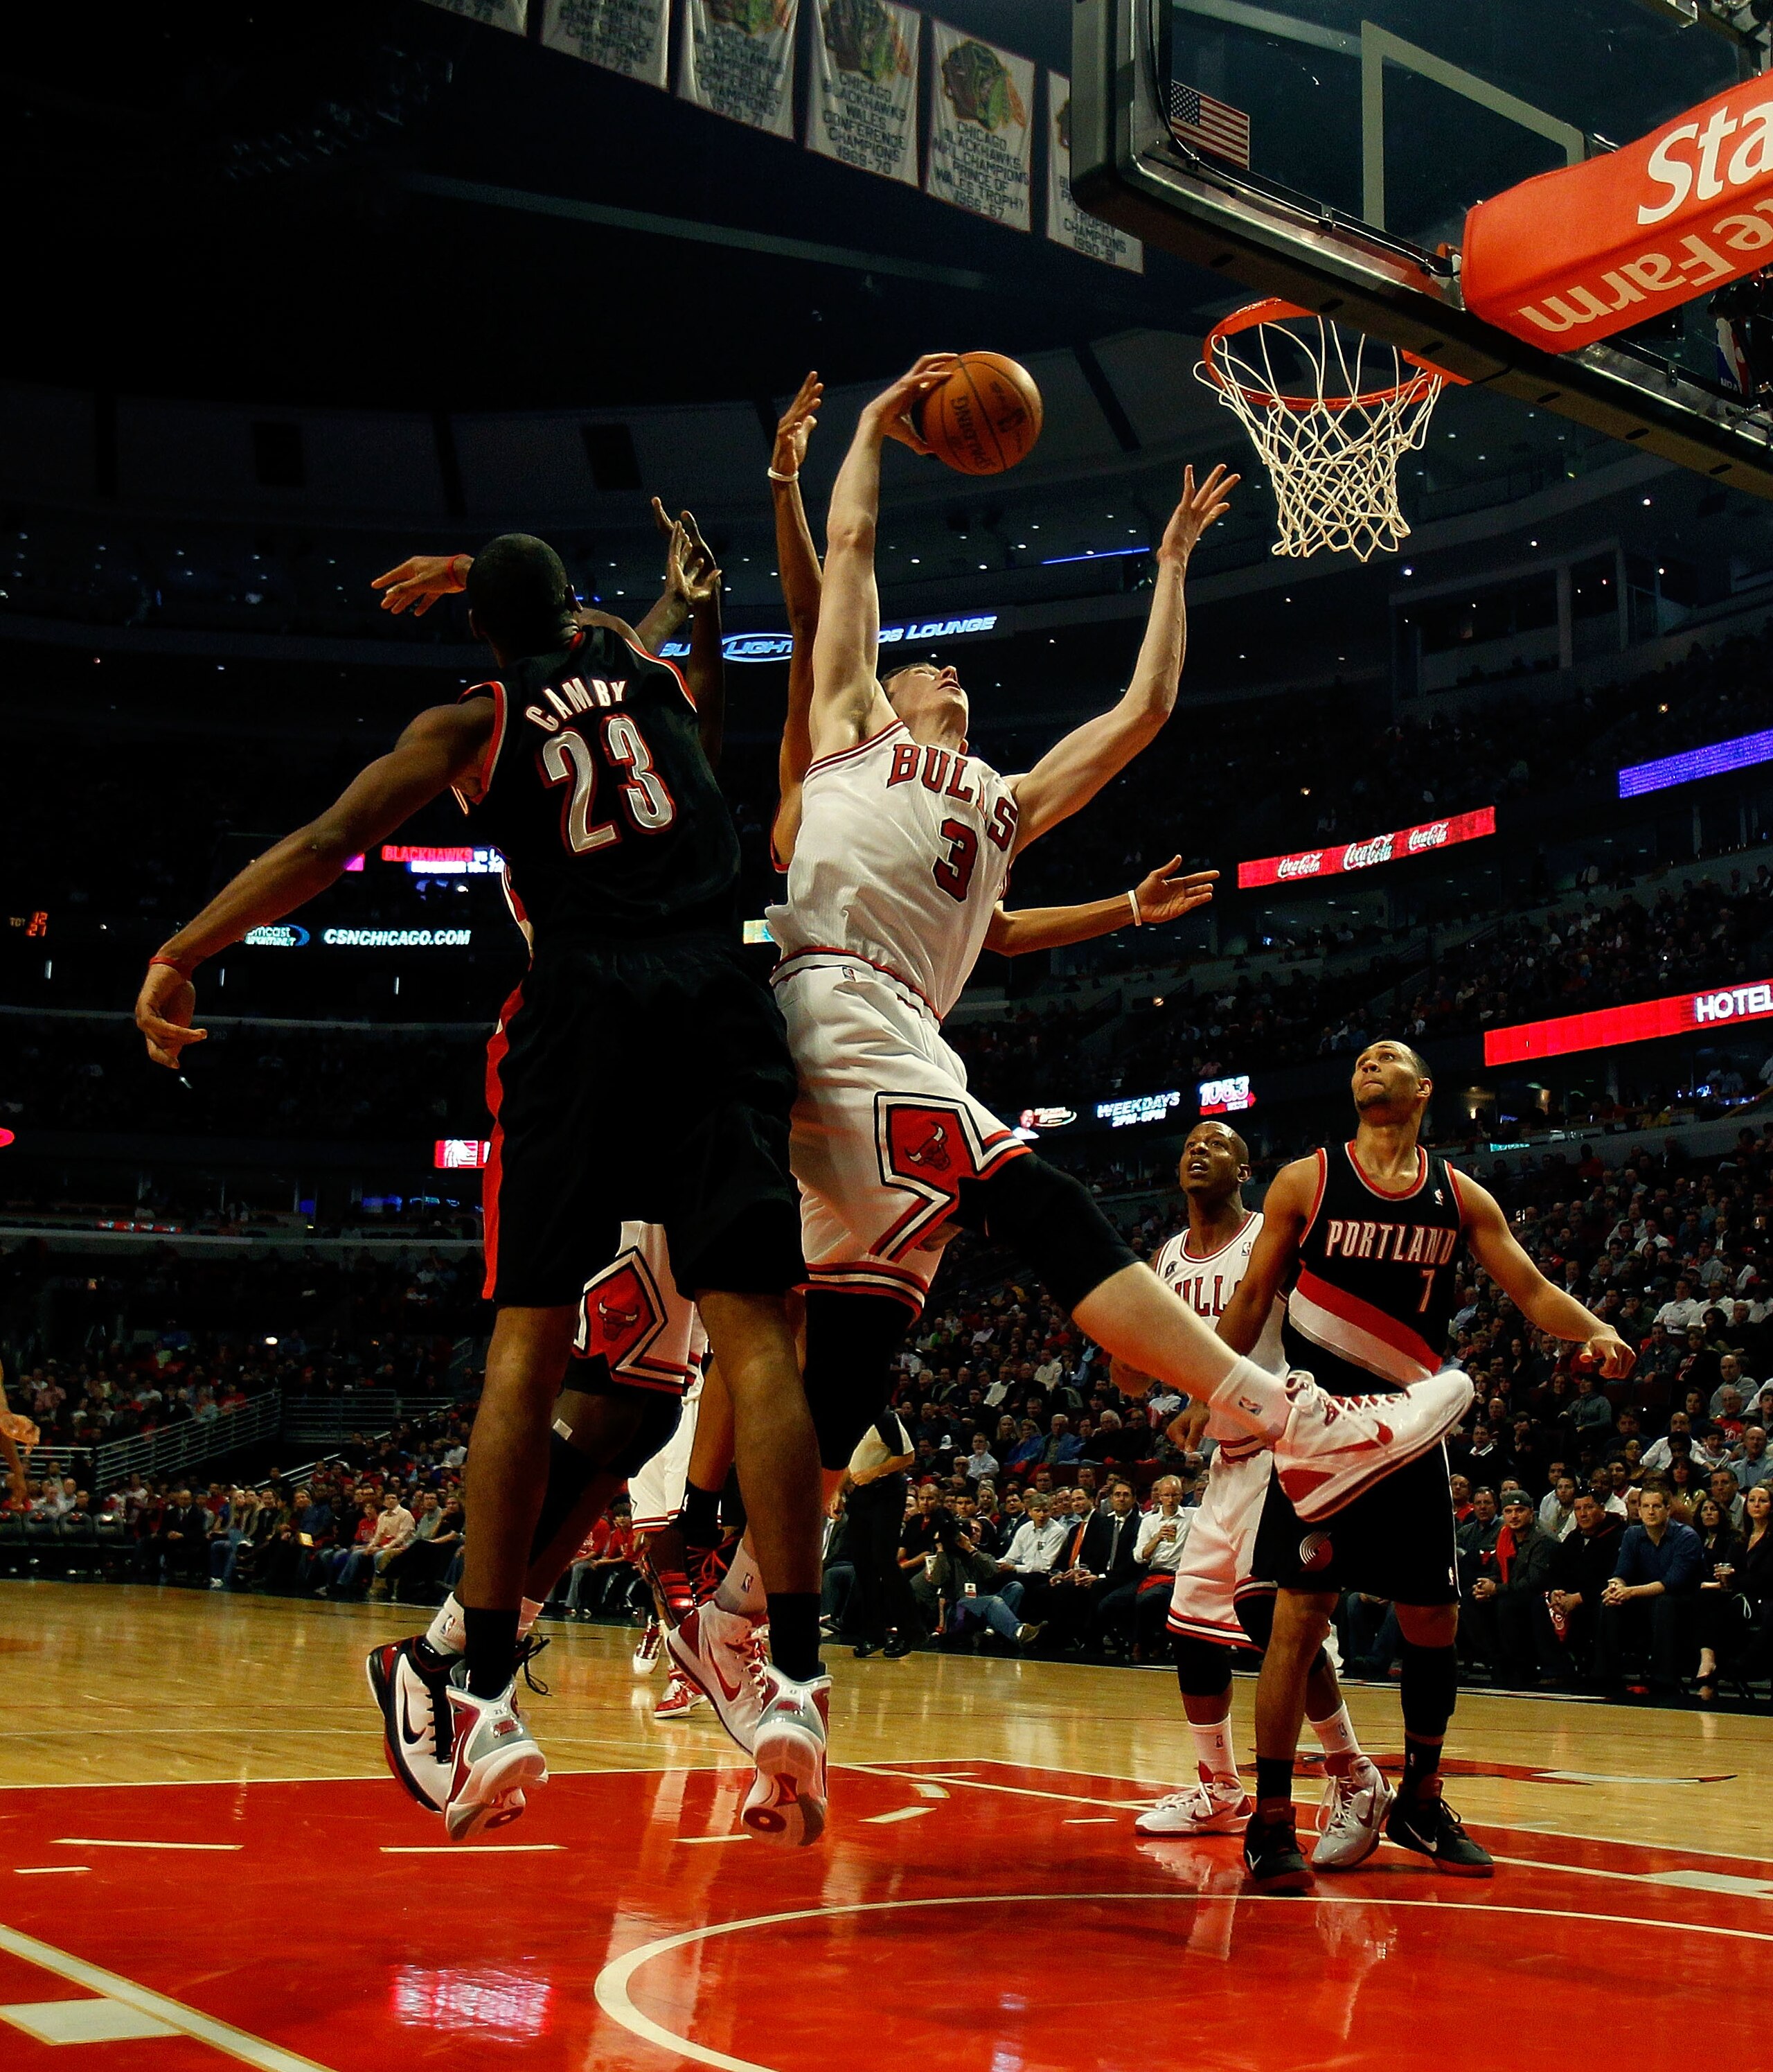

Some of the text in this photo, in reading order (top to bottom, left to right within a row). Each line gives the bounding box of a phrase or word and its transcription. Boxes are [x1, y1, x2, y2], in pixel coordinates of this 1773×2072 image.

[839, 72, 891, 103] CHICAGO
[823, 109, 906, 150] CONFERENCE
[846, 104, 886, 130] WALES
[829, 126, 900, 162] CHAMPIONS
[943, 128, 1022, 170] BLACKHAWKS
[957, 121, 1007, 152] CHICAGO
[936, 166, 1024, 212] WALES TROPHY
[952, 159, 1009, 192] PRINCE OF
[1064, 218, 1127, 254] CHAMPIONS
[1517, 233, 1736, 333] Farm
[905, 615, 997, 639] LOUNGE
[525, 677, 627, 732] CAMBY
[534, 714, 677, 858] 23
[382, 845, 473, 862] BLACKHAWKS
[931, 817, 979, 903] 3
[324, 928, 472, 946] CSNCHICAGO.COM
[1096, 1091, 1180, 1118] WEEKDAYS
[1325, 1219, 1457, 1265] PORTLAND
[1418, 1268, 1436, 1313] 7
